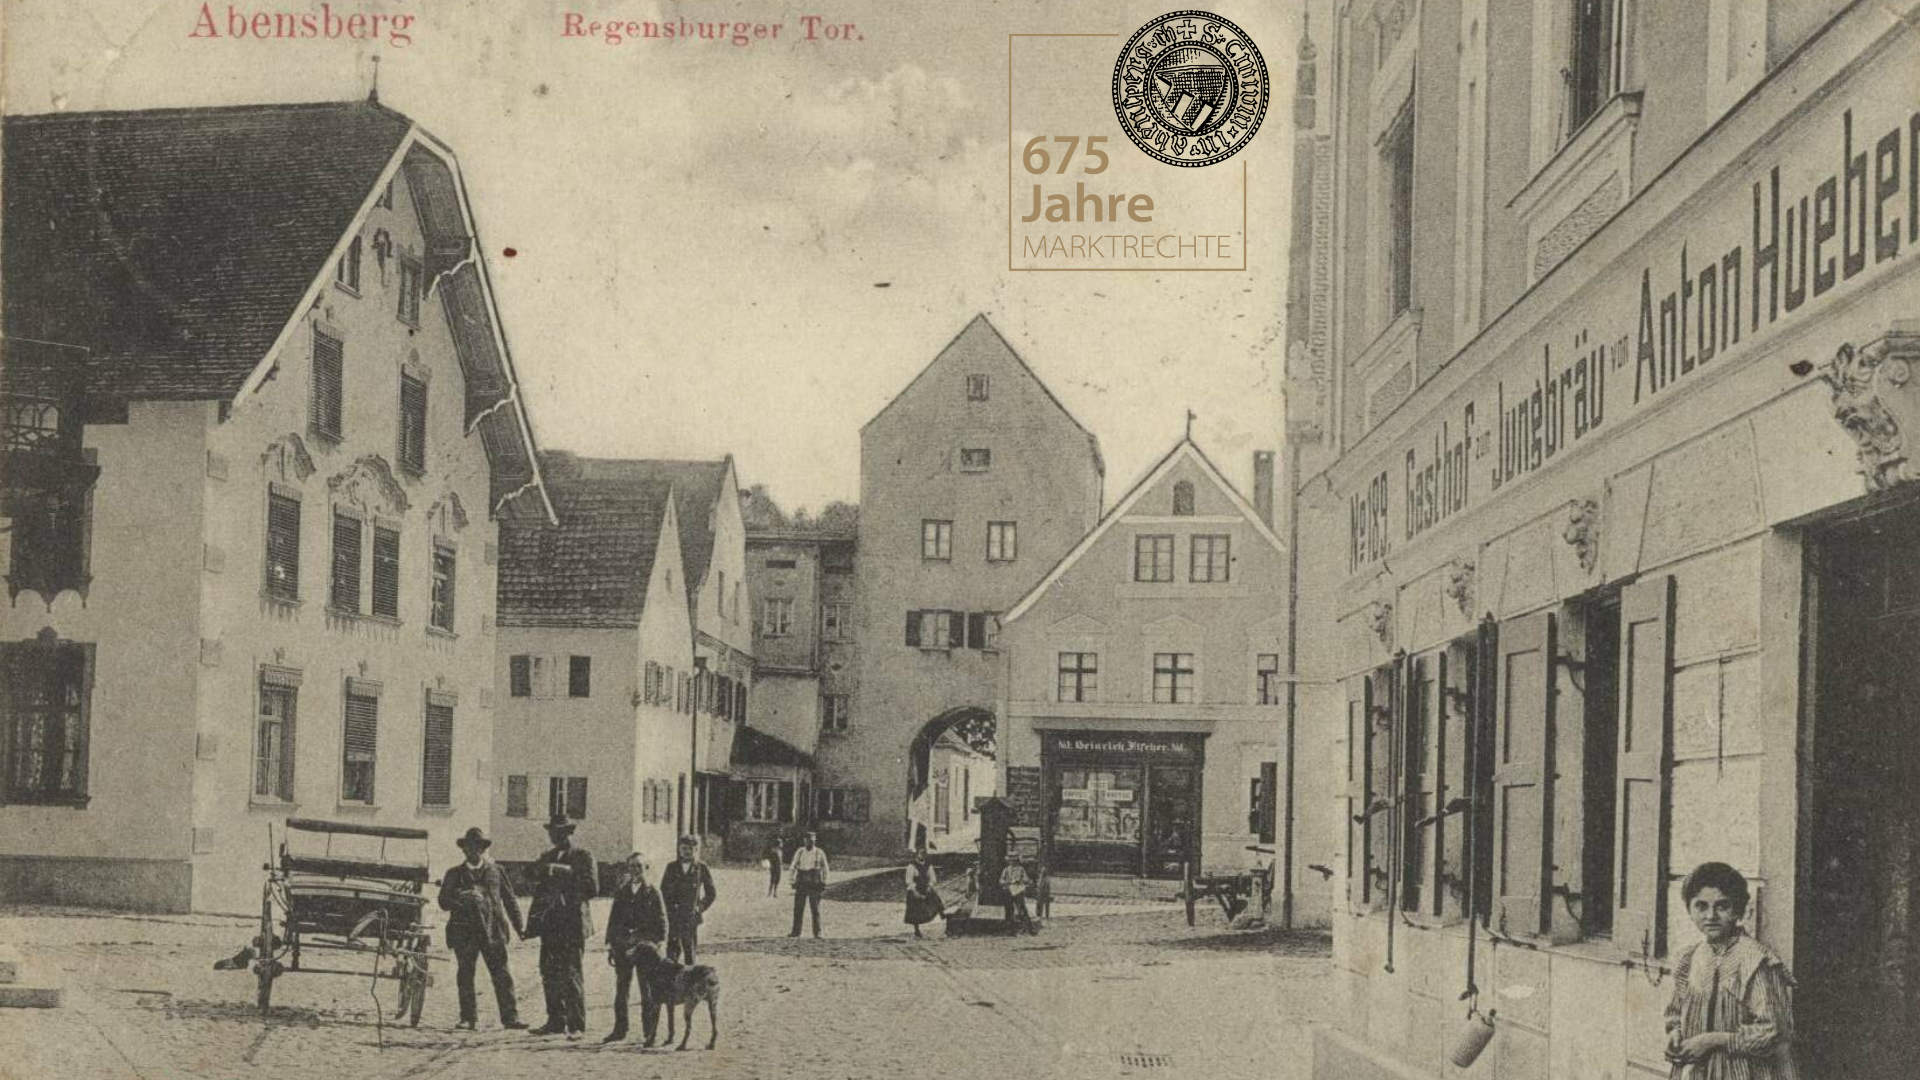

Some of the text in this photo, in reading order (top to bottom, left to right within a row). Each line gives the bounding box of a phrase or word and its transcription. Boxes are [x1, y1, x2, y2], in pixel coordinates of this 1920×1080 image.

[1406, 400, 1474, 541] Gasthof
[1492, 328, 1604, 491] Jungbräu
[1634, 238, 1741, 404] Anton
